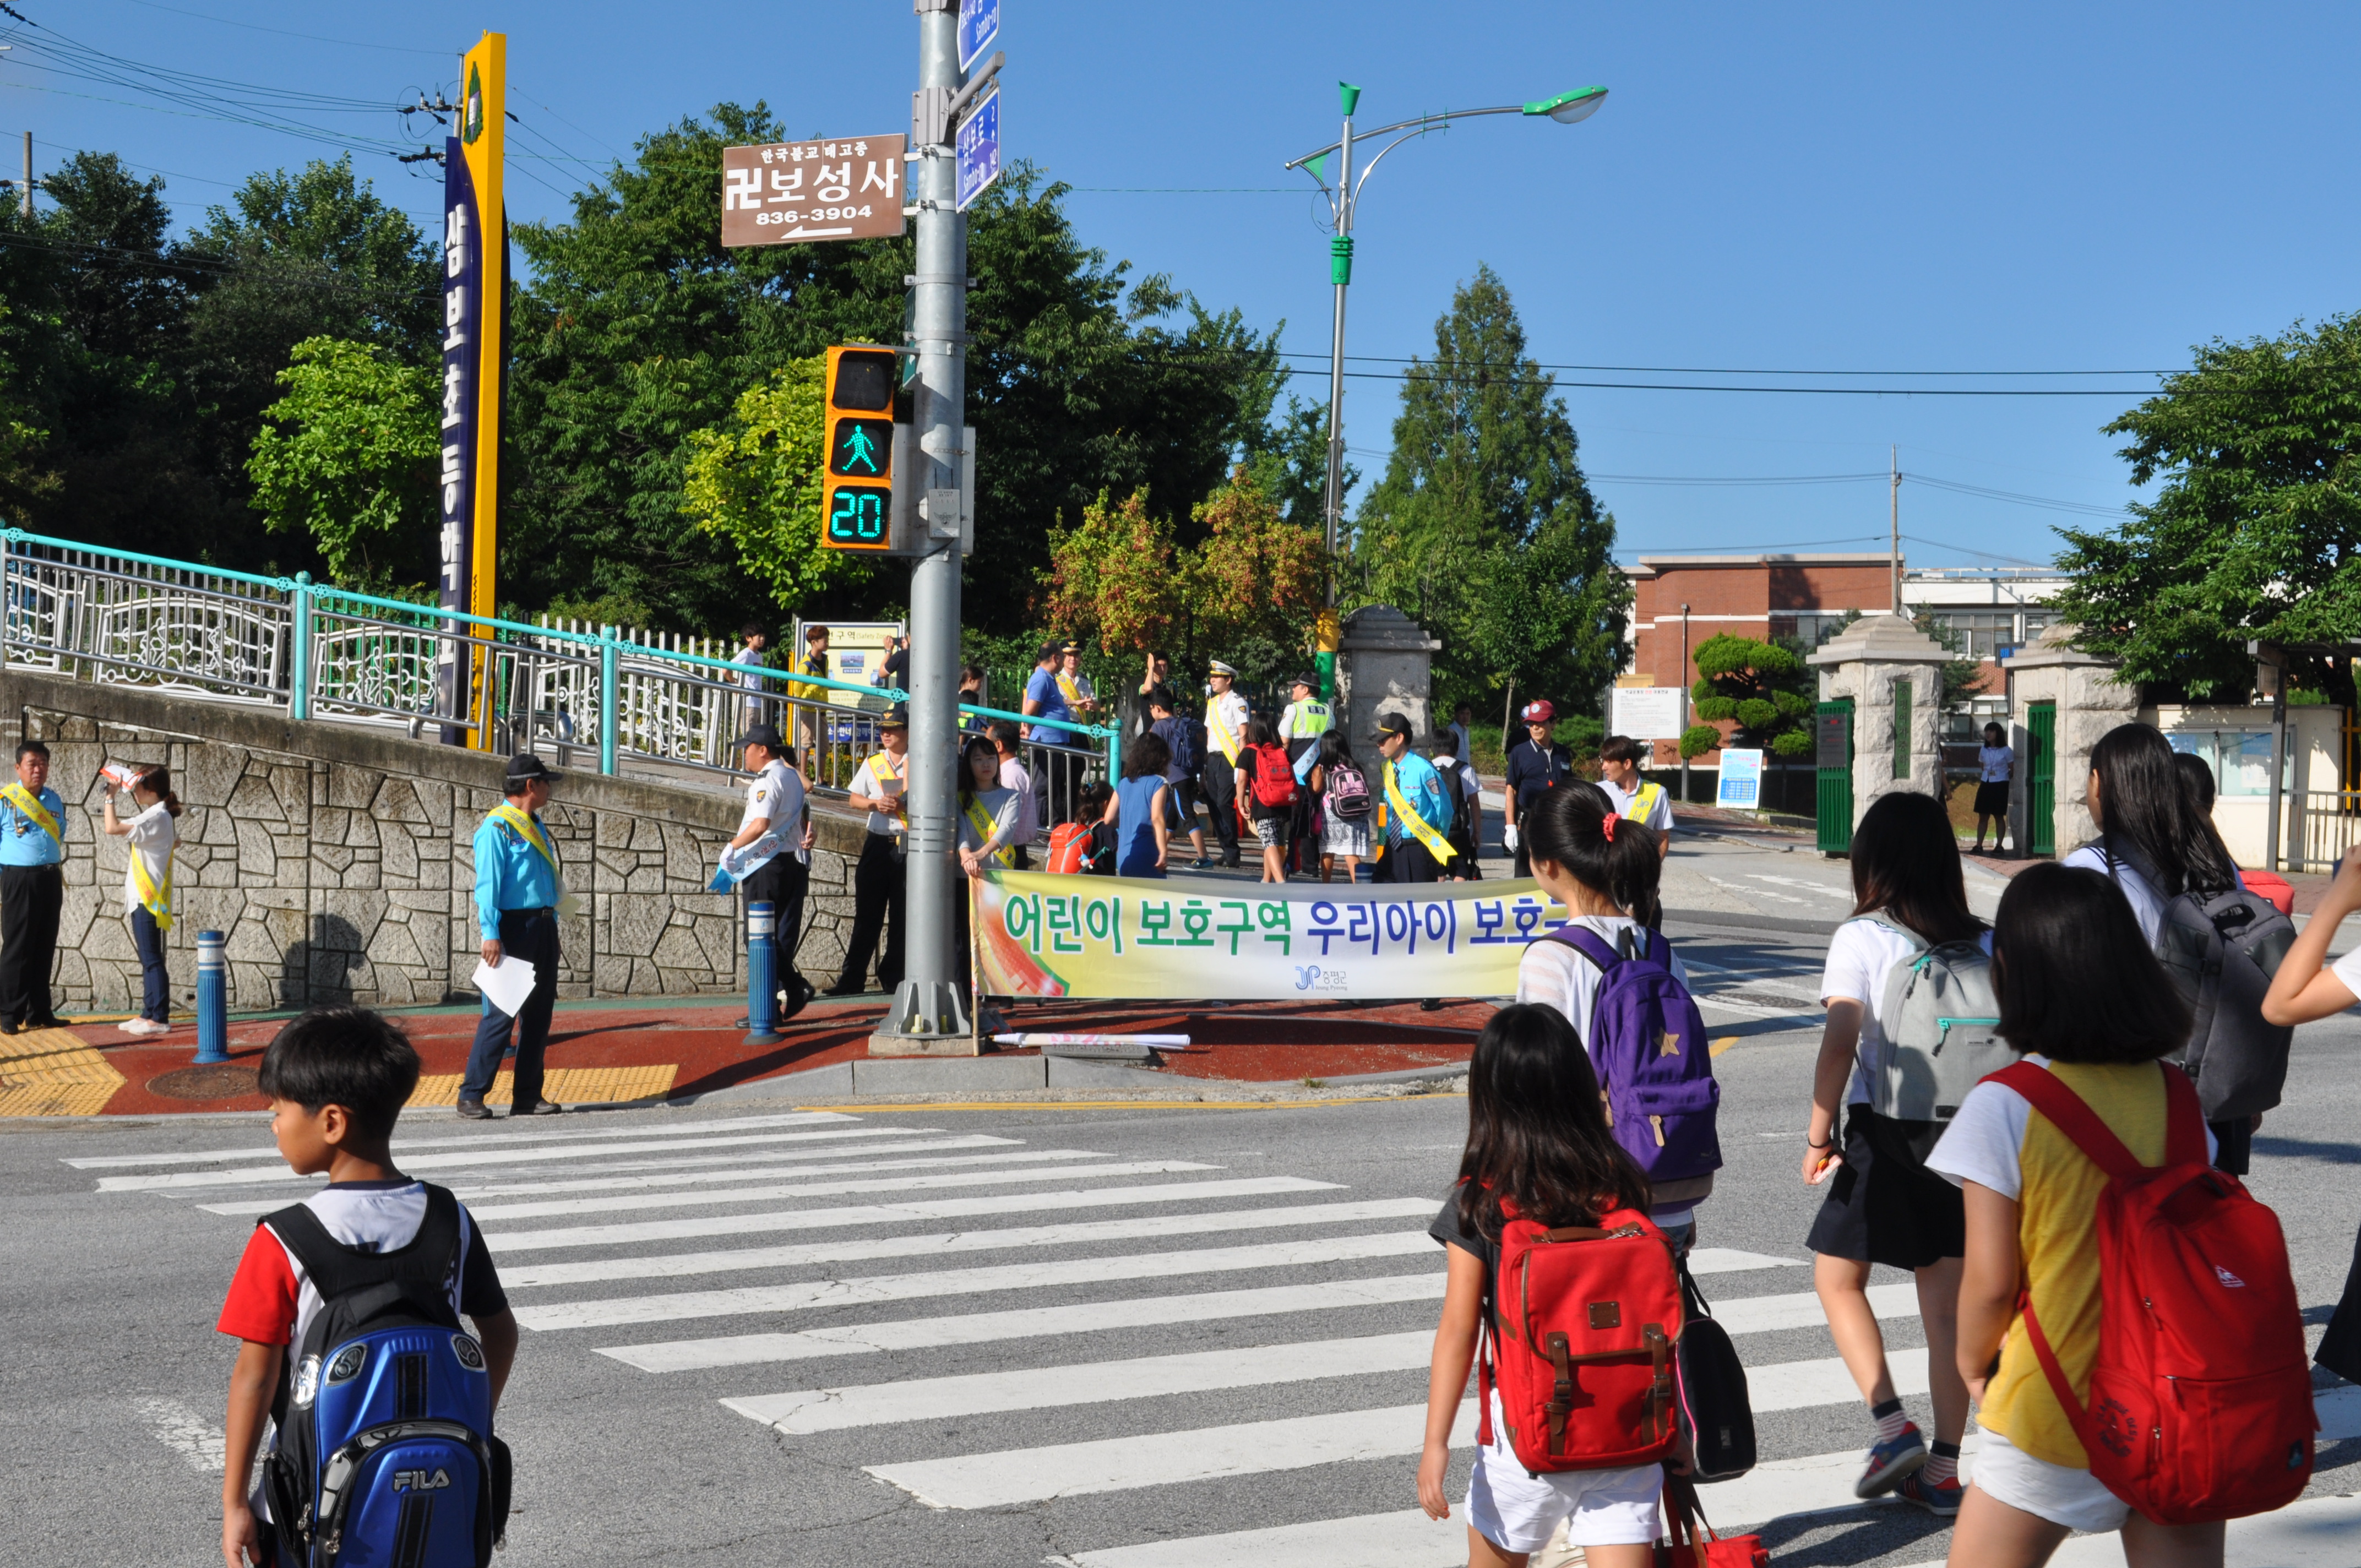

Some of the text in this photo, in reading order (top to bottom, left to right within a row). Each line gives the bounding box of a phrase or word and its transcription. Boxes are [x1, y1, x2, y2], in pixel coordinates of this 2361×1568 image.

[976, 6, 997, 43] Sambo-ro
[963, 115, 984, 168] 삼보로
[964, 161, 984, 195] Sambo-ro
[755, 205, 872, 225] 836-3904
[832, 492, 880, 537] 20
[1006, 894, 1122, 954] 어린이
[1136, 900, 1292, 956] 보호구역
[1307, 900, 1456, 955] 우리아이
[1323, 971, 1347, 984] 증평군
[394, 1469, 450, 1491] FILA
